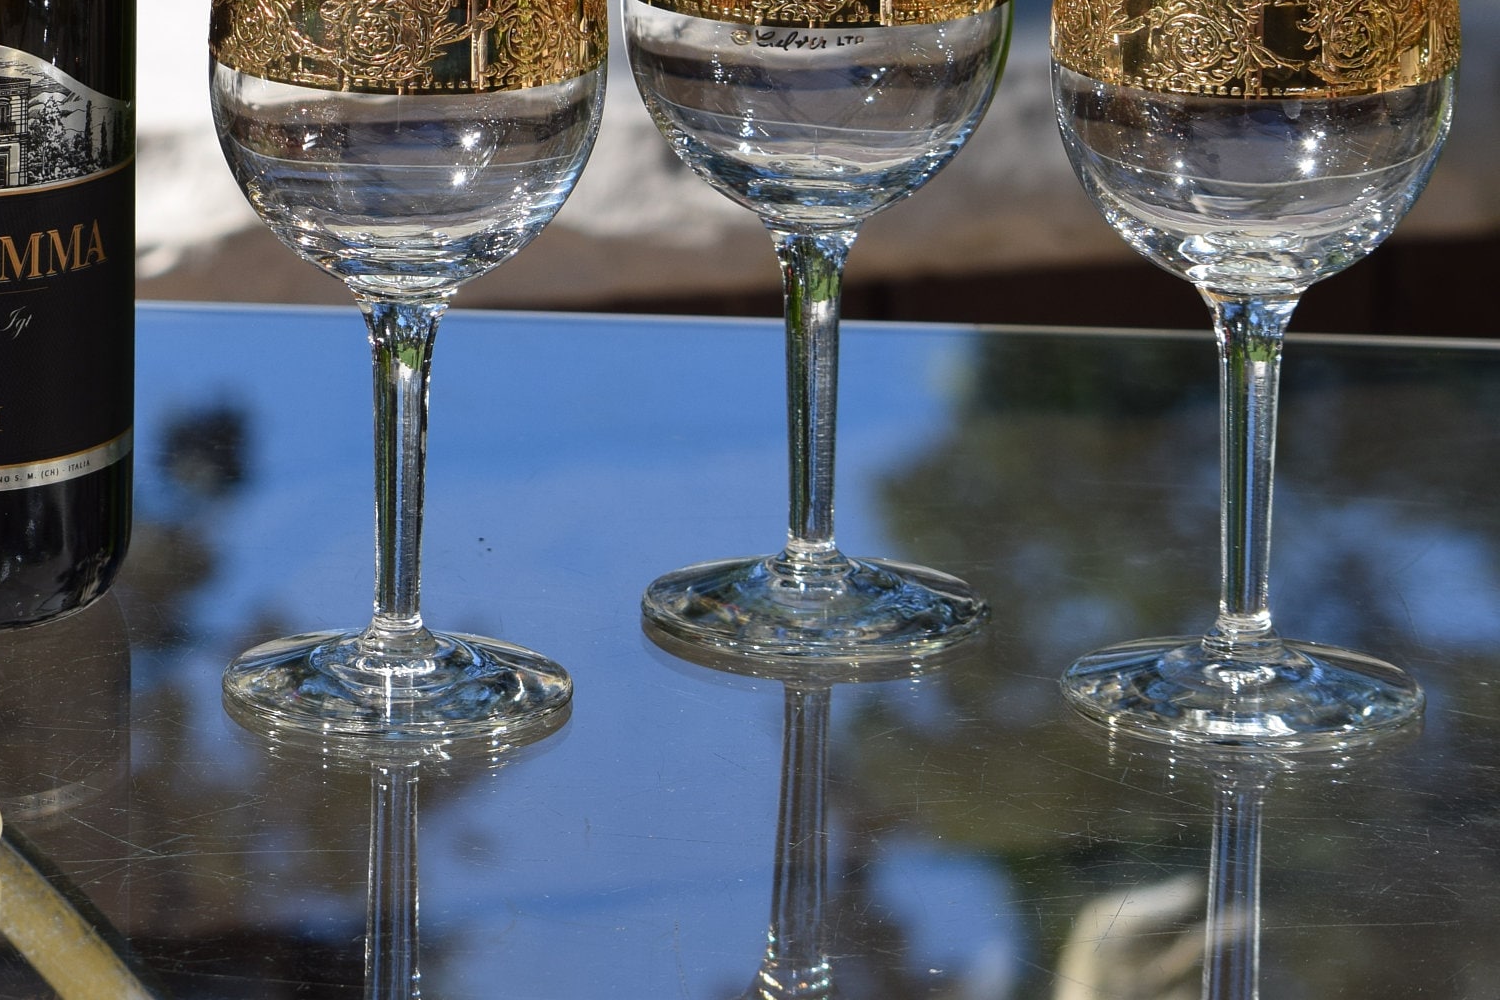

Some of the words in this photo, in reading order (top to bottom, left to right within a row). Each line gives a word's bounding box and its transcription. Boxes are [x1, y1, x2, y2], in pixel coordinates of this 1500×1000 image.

[836, 34, 864, 47] LTD
[14, 473, 23, 483] S.
[27, 471, 37, 481] M.
[41, 467, 59, 479] (CH)
[68, 459, 91, 473] ITALIA
